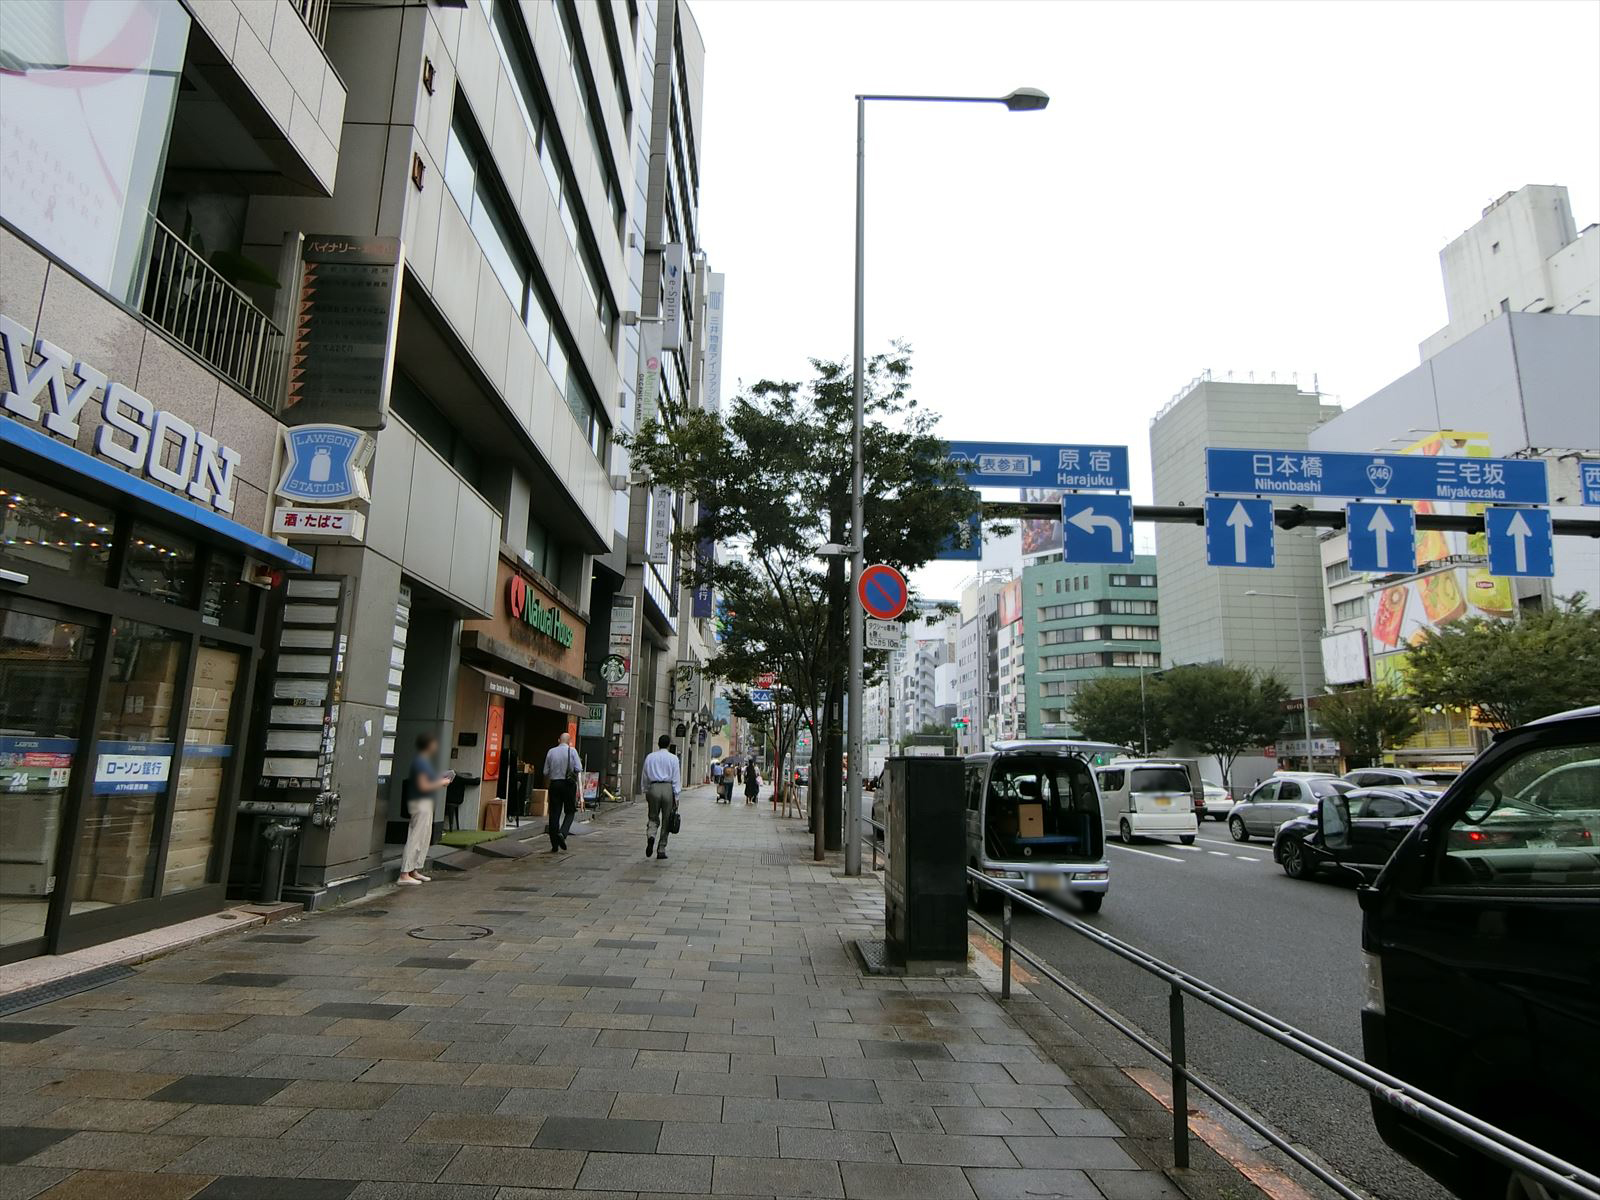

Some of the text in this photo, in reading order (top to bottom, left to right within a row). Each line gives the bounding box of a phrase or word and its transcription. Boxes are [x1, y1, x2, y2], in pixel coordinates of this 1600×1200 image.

[668, 280, 679, 323] e-Spirit
[0, 314, 241, 514] WSON
[295, 431, 353, 449] LAWSON
[982, 457, 1026, 473] 表参道
[1057, 448, 1111, 472] 原宿
[1252, 454, 1322, 478] 日本橋
[1057, 473, 1113, 487] Harajuku
[1370, 467, 1389, 481] 246
[1436, 462, 1505, 485] 三宅坂
[289, 479, 347, 494] STATION
[1254, 477, 1321, 493] Nihonbashi
[1436, 484, 1506, 500] Miyakezaka
[283, 512, 343, 530] 酒・たばこ
[524, 585, 574, 649] Natural House
[106, 761, 162, 775] ローソン銀行
[11, 772, 29, 786] 24
